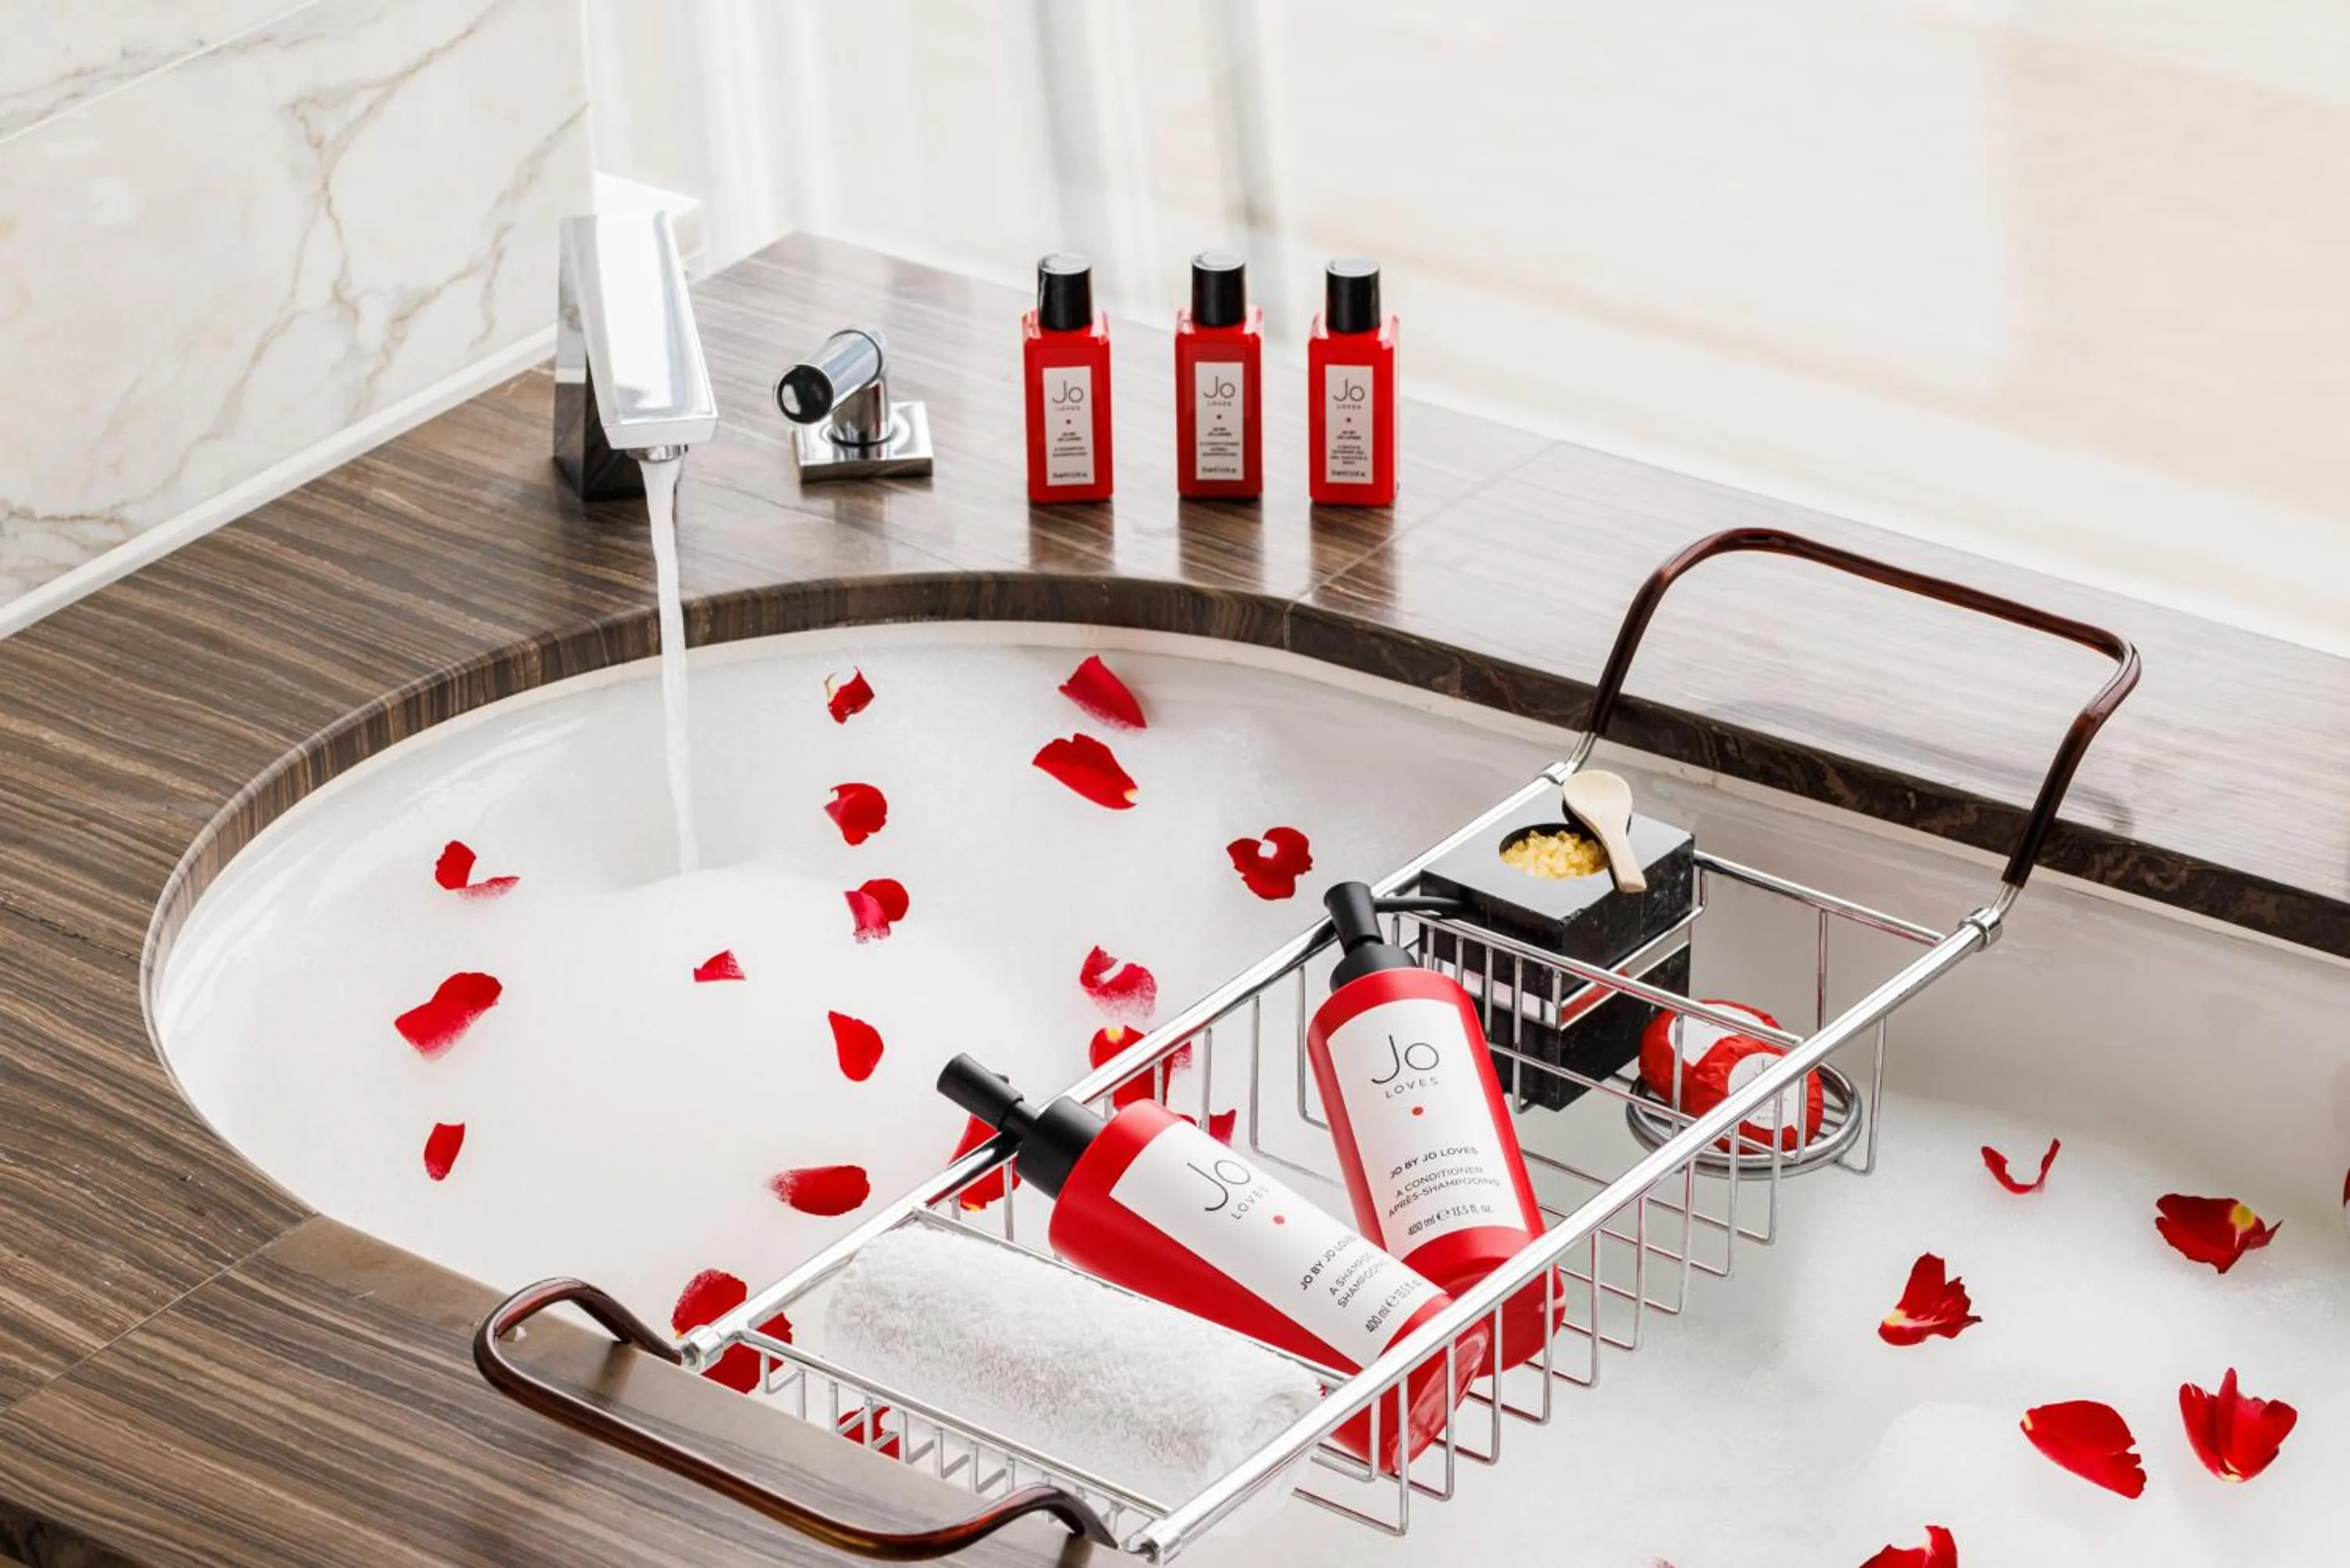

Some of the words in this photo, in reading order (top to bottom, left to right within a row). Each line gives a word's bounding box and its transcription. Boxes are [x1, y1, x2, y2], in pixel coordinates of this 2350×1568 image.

[1052, 381, 1084, 403] Jo
[1202, 376, 1235, 399] Jo
[1332, 378, 1365, 402] Jo
[1371, 1035, 1439, 1085] Jo
[1385, 1077, 1439, 1099] LOVES
[1390, 1166, 1403, 1180] JO
[1405, 1158, 1419, 1169] BY
[1422, 1152, 1437, 1162] JO
[1440, 1146, 1478, 1157] LOVES
[1187, 1160, 1251, 1212] Jo
[1396, 1190, 1404, 1198] A
[1408, 1221, 1423, 1235] 400
[1300, 1274, 1314, 1291] JO
[1311, 1260, 1325, 1275] BY
[1323, 1249, 1336, 1263] JO
[1329, 1286, 1339, 1296] A
[1336, 1252, 1374, 1287] SHAMPO
[1365, 1315, 1383, 1333] 400
